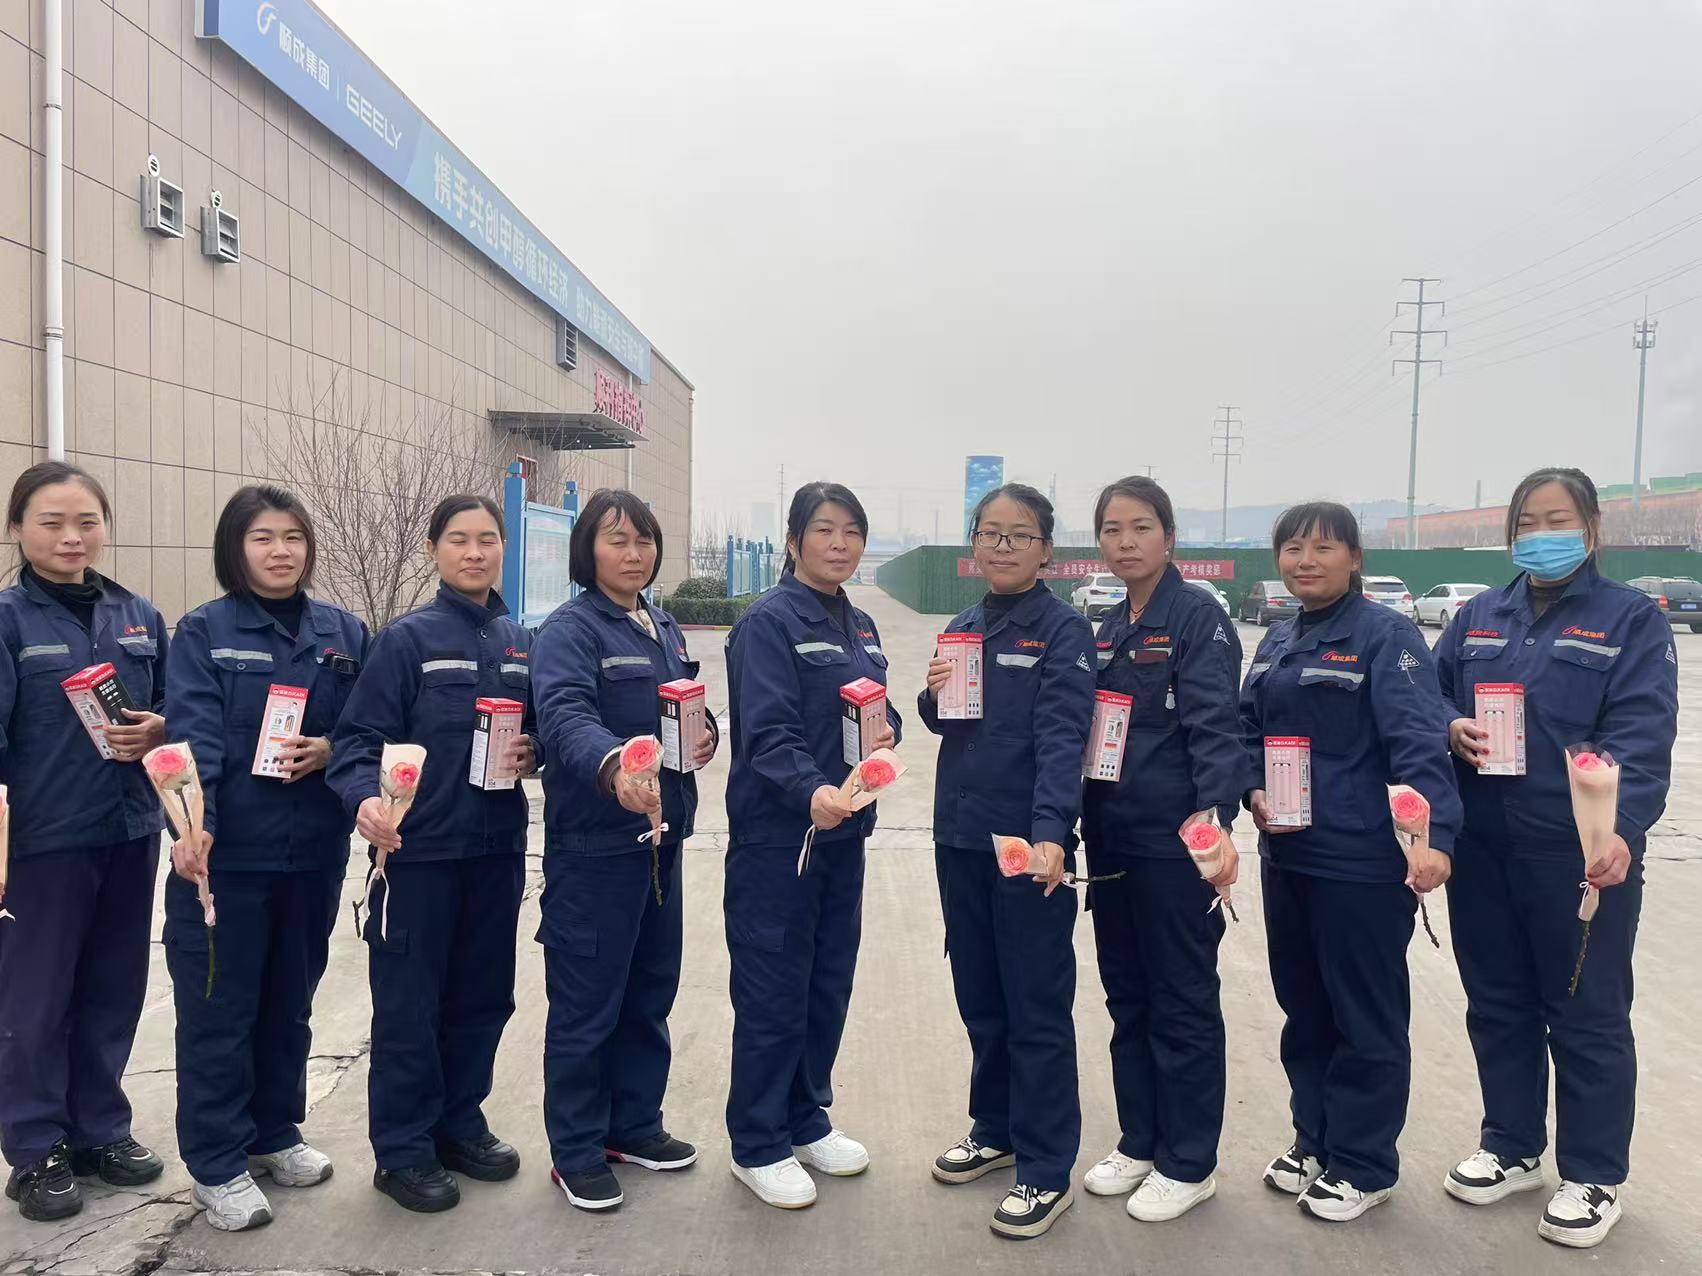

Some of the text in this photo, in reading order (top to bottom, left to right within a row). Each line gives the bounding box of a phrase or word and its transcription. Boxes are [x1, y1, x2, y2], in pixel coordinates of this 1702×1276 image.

[280, 21, 330, 91] 顺成集团
[346, 84, 402, 151] GEELY
[433, 151, 568, 308] 携手共创甲醇循环经济
